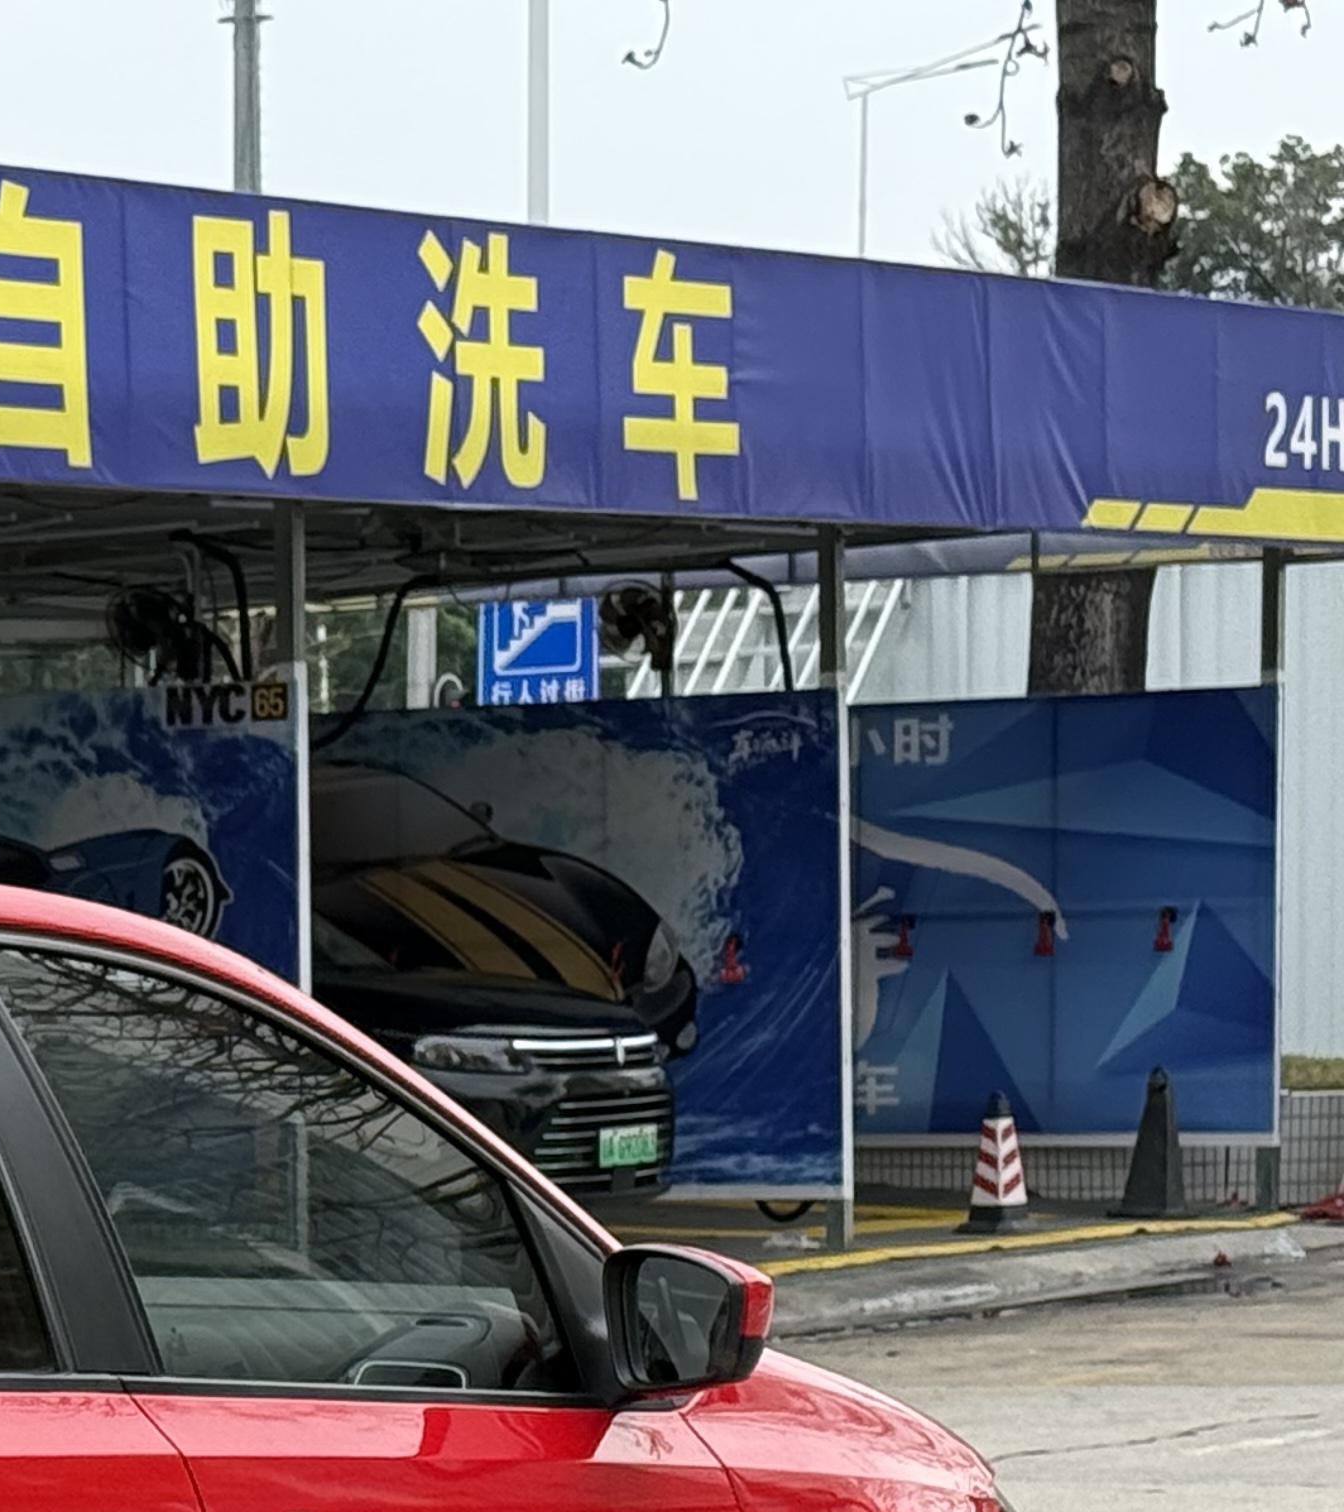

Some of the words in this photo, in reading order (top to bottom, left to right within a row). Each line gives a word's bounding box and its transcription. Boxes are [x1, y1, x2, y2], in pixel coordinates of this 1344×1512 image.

[1265, 391, 1344, 472] 24H
[166, 683, 246, 726] NYC
[255, 687, 285, 718] 65
